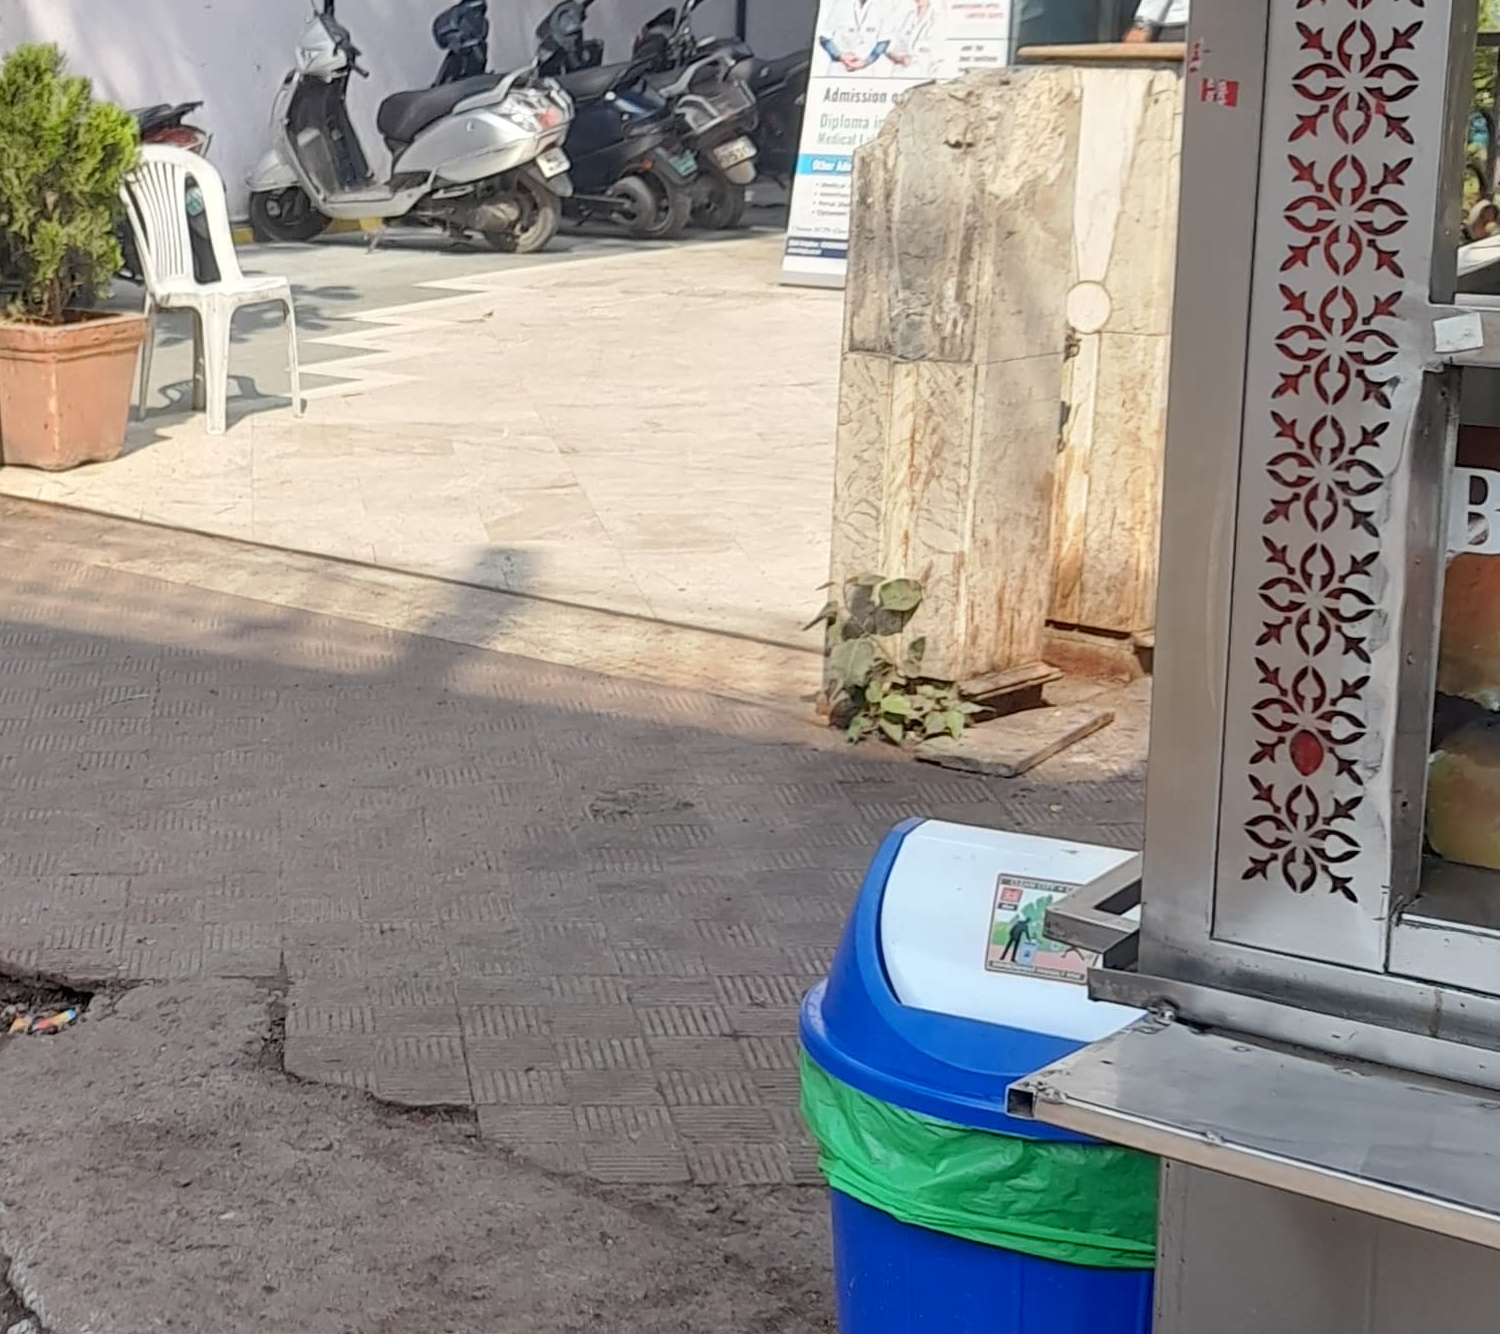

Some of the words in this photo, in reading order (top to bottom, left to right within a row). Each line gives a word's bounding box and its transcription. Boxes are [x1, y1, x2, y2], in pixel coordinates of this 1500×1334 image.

[822, 87, 888, 104] Admission
[819, 113, 870, 132] Diploma
[817, 132, 856, 146] Medical
